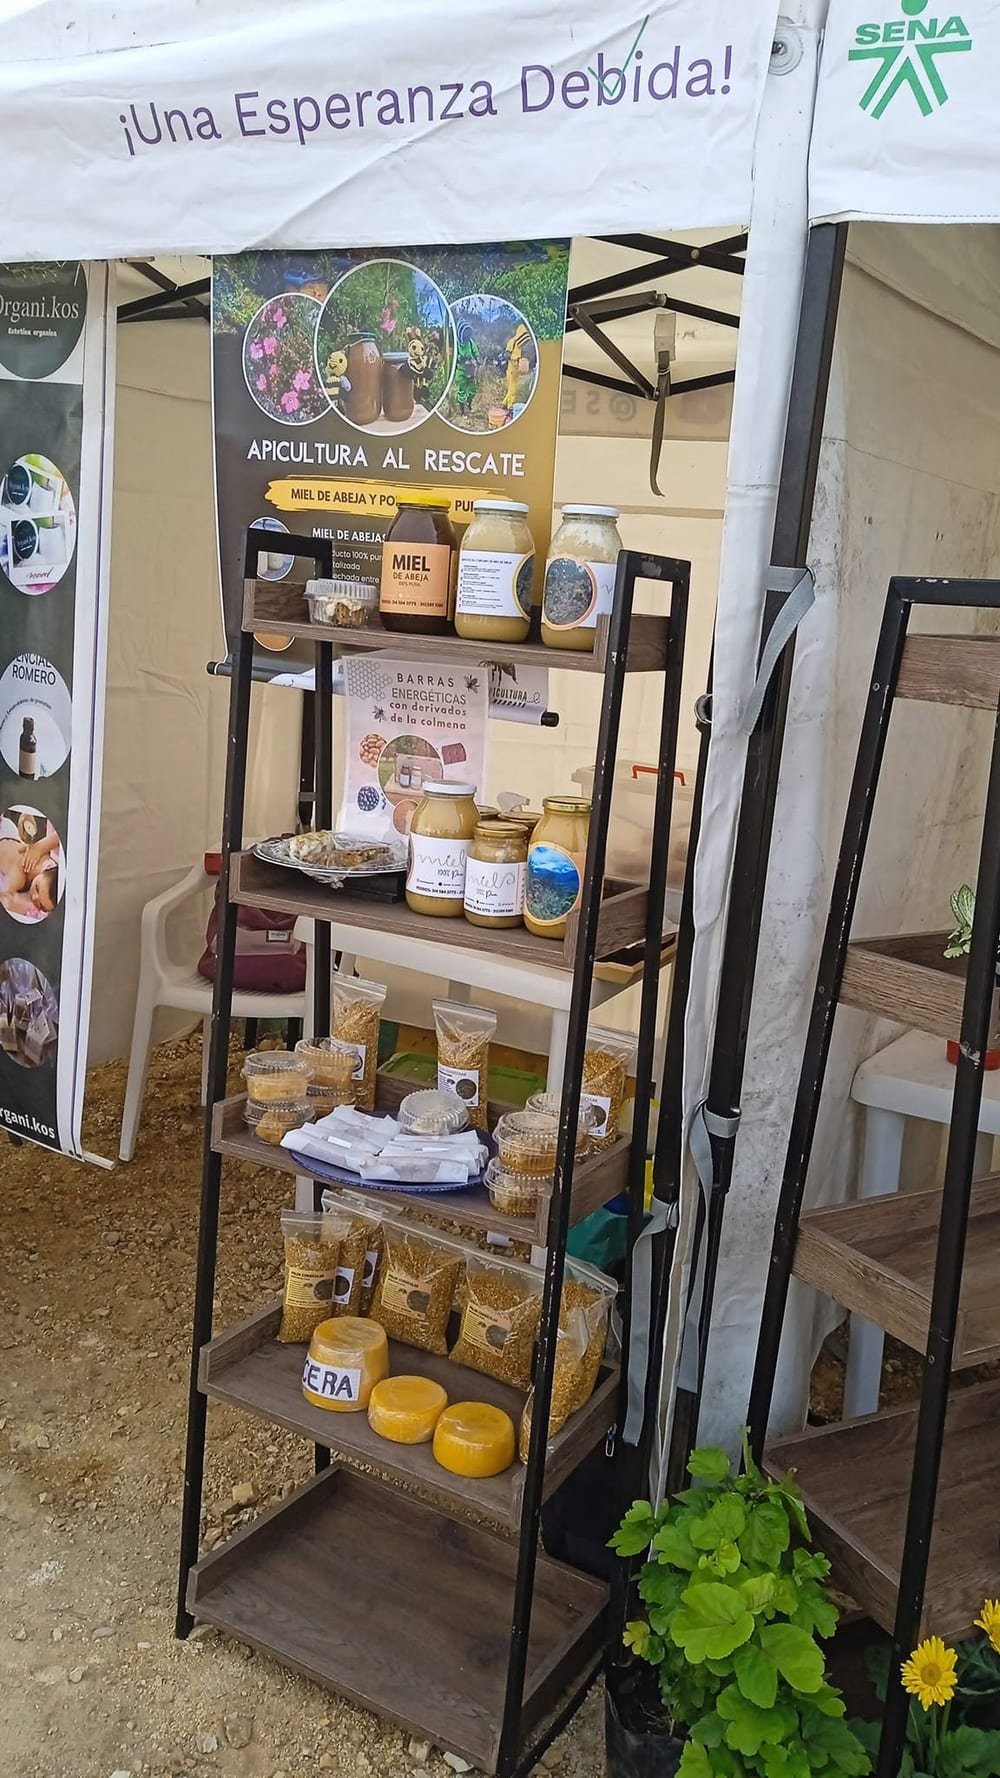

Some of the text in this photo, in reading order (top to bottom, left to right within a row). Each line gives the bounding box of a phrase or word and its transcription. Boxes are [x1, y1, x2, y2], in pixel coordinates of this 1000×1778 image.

[855, 16, 969, 45] SENA
[119, 44, 733, 156] ¡Una Esperanza Debida!
[246, 439, 526, 477] APICULTURA AL RESCATE
[291, 488, 314, 501] MIEL
[317, 490, 331, 502] DE
[333, 492, 367, 505] ABEJA
[368, 494, 377, 505] Y
[312, 527, 335, 539] MIEL
[337, 530, 350, 541] DE
[352, 551, 369, 560] 100%
[392, 554, 430, 572] MIEL
[361, 576, 380, 584] entre
[393, 572, 429, 582] DE ABEJA
[12, 664, 56, 686] ROMERO
[397, 673, 454, 687] BARRAS
[391, 687, 467, 705] ENERGÉTICAS
[389, 702, 467, 716] con derivados
[390, 713, 466, 730] de la colmena
